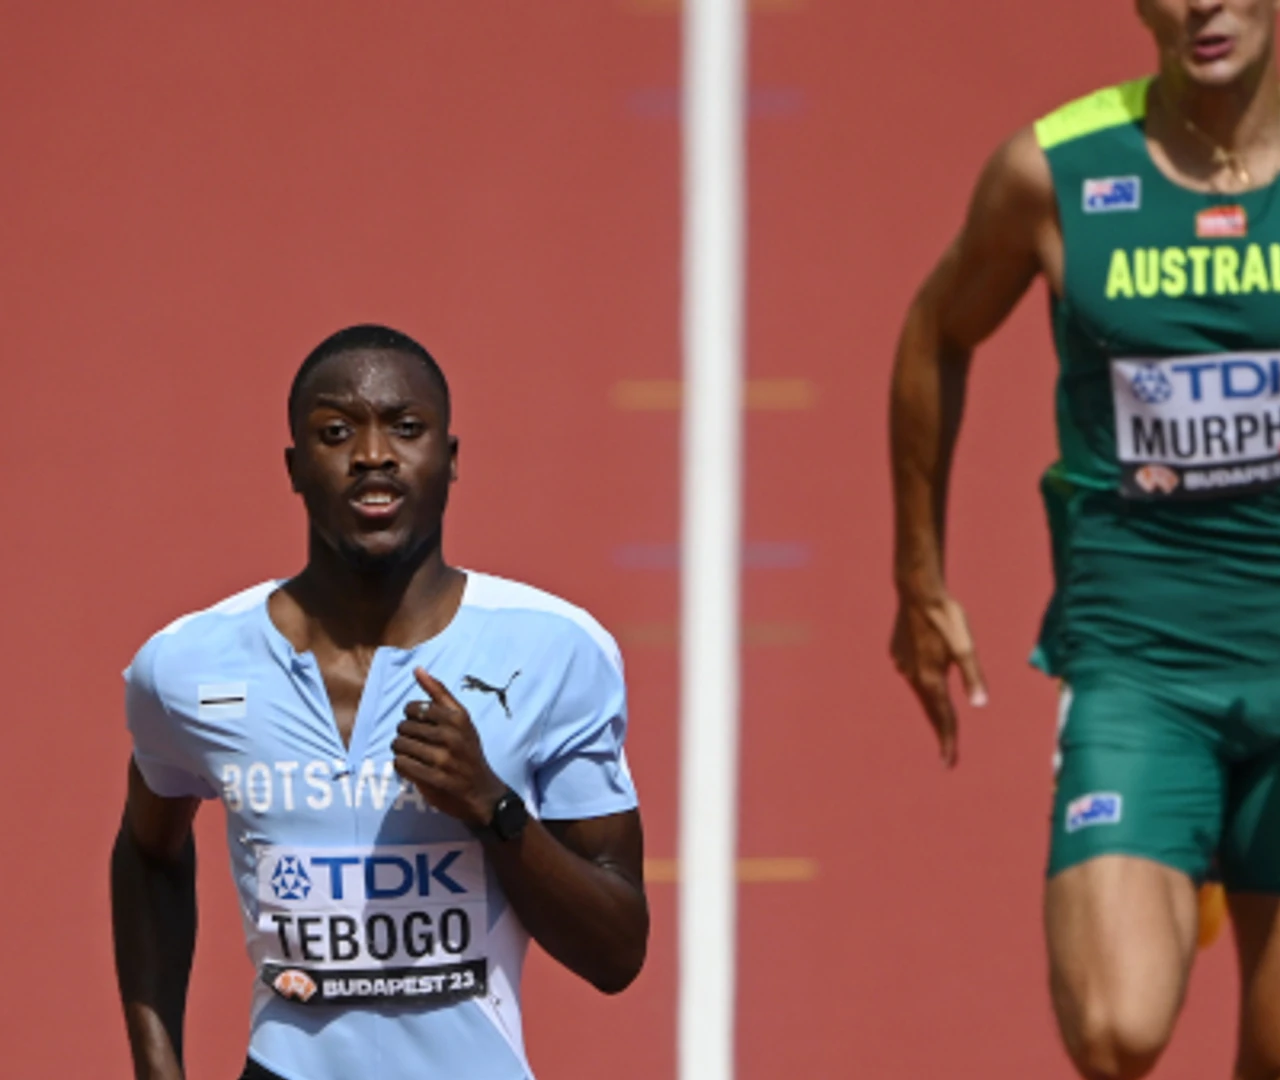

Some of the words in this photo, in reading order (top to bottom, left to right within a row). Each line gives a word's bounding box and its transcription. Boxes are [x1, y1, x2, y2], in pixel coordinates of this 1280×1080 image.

[310, 850, 468, 900] TDK
[272, 907, 470, 961] TEBOGO
[322, 975, 445, 997] BUDAPEST
[451, 972, 475, 989] 23
